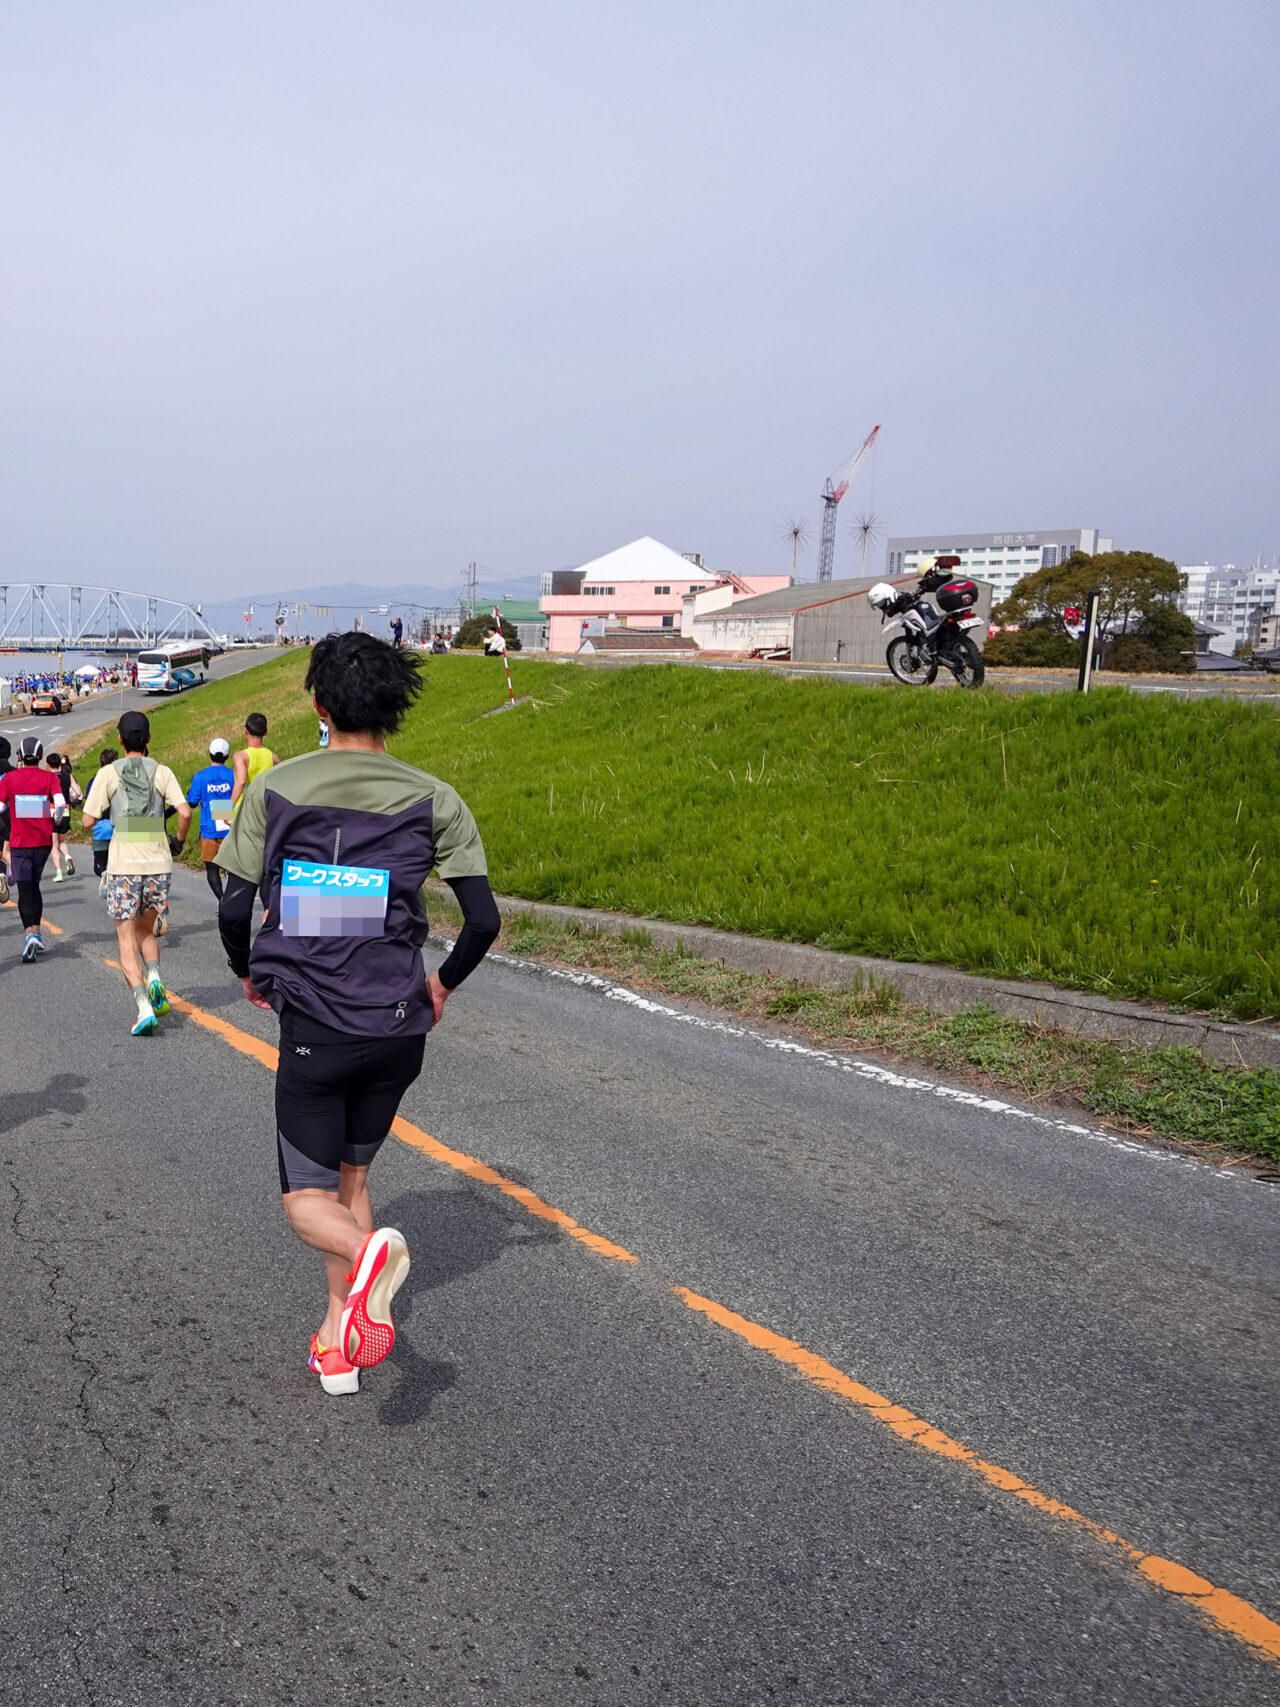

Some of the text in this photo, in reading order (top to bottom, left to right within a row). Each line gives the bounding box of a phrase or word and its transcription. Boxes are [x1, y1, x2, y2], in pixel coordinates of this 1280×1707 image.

[287, 865, 384, 887] ワークスタッフ
